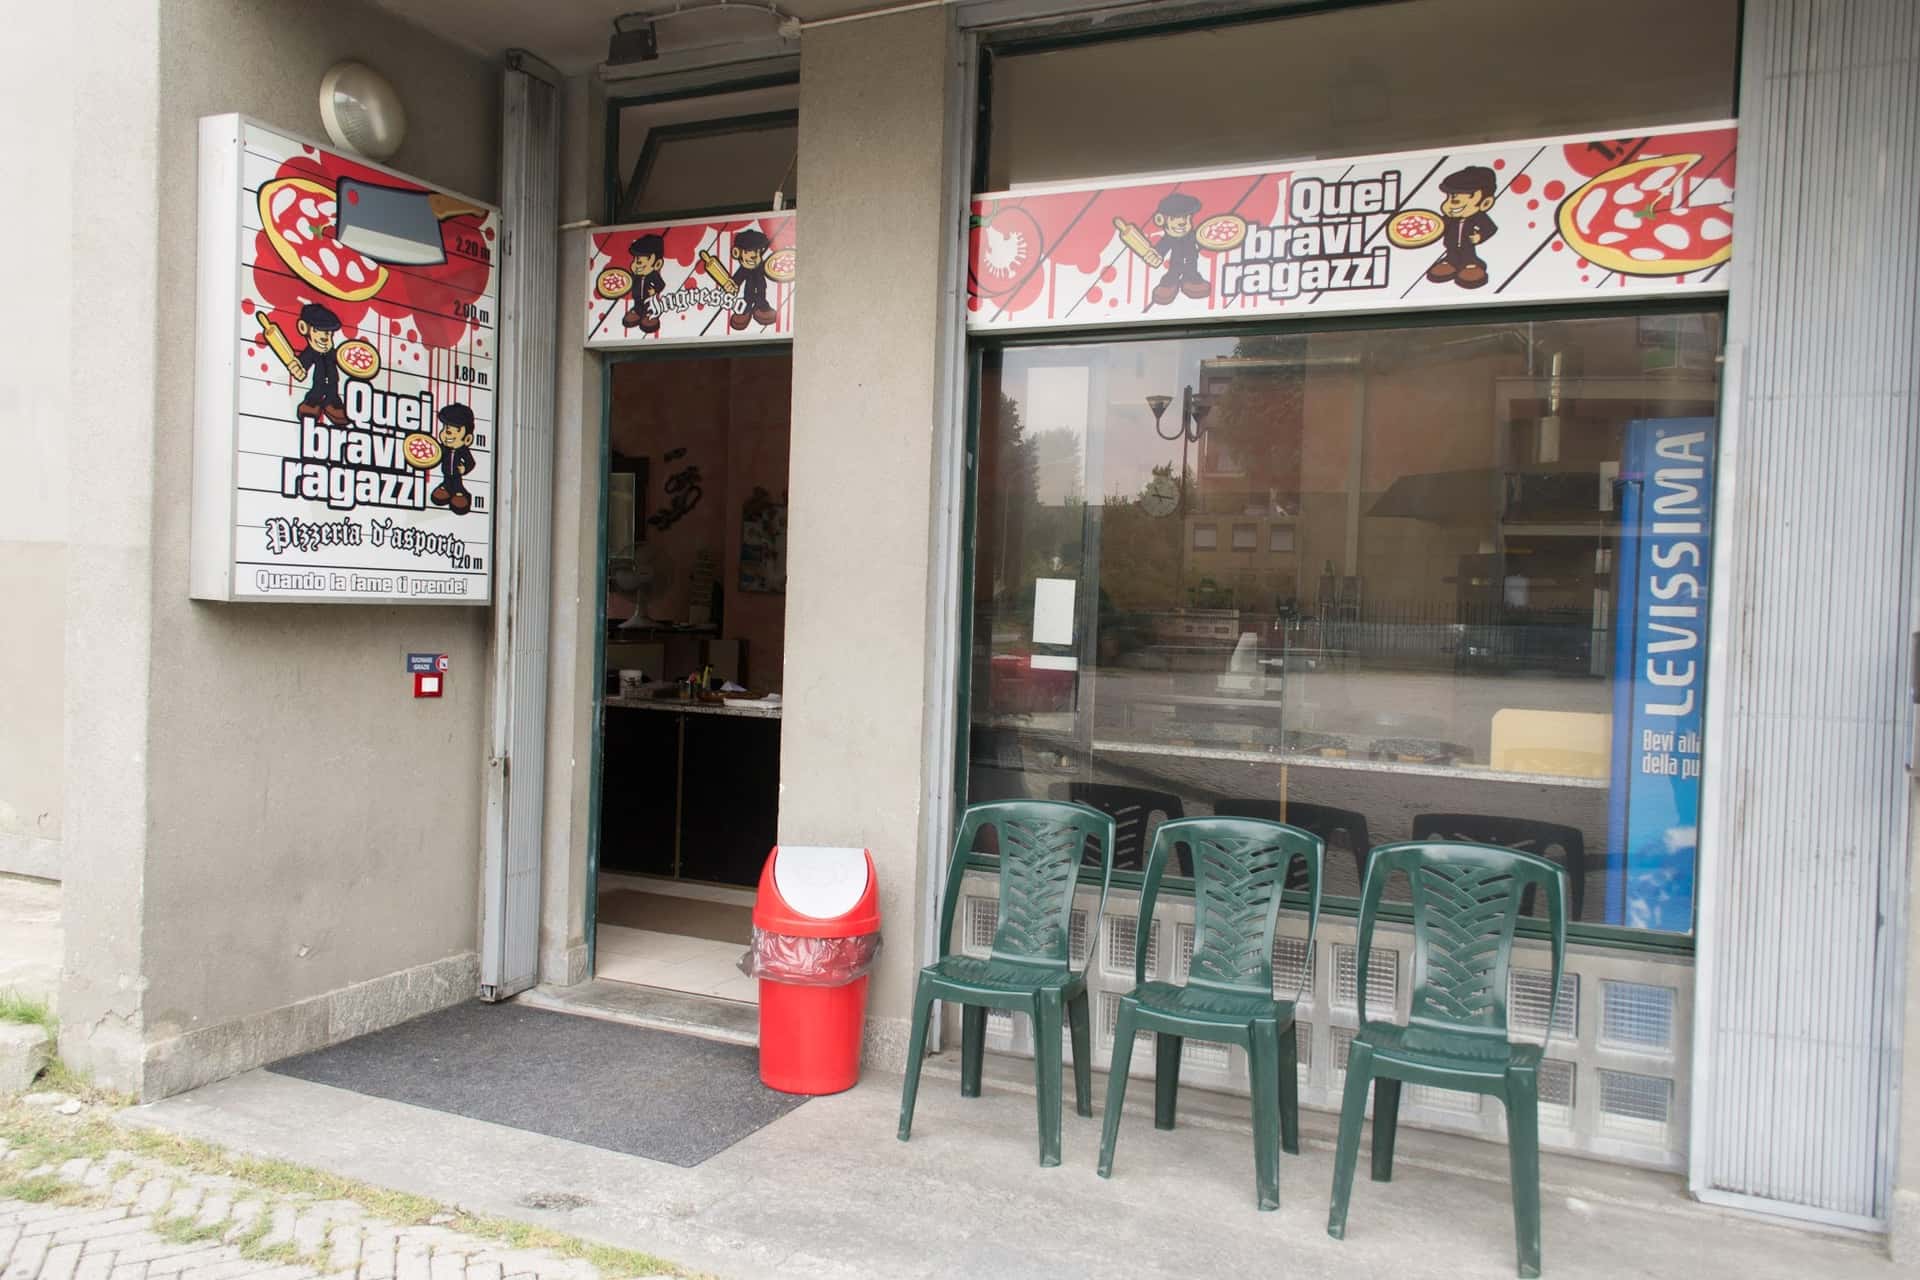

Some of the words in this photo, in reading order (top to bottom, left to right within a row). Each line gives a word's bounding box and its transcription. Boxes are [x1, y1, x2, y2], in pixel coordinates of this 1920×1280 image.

[1290, 170, 1401, 222] Quei
[456, 235, 479, 257] 2.20
[481, 247, 490, 260] m
[1243, 217, 1365, 260] bravi
[1223, 246, 1390, 300] ragazzi
[454, 299, 477, 318] 2.00
[480, 309, 489, 323] m
[644, 288, 747, 319] Ingresso
[455, 365, 476, 384] 1.80
[477, 373, 488, 385] m
[346, 379, 433, 433] Quei
[300, 416, 405, 471] bravi
[476, 434, 487, 447] m
[282, 457, 426, 511] ragazzi
[475, 496, 485, 508] m
[266, 517, 362, 554] Pizzeria
[371, 518, 465, 559] d'asporto
[473, 557, 483, 570] m
[1644, 431, 1705, 716] LEVISSIMA
[256, 570, 325, 591] Quando
[330, 573, 346, 591] la
[351, 574, 392, 592] fame
[397, 576, 408, 593] ti
[411, 577, 468, 595] prende!
[1643, 729, 1674, 751] Bevi
[1642, 752, 1677, 775] della
